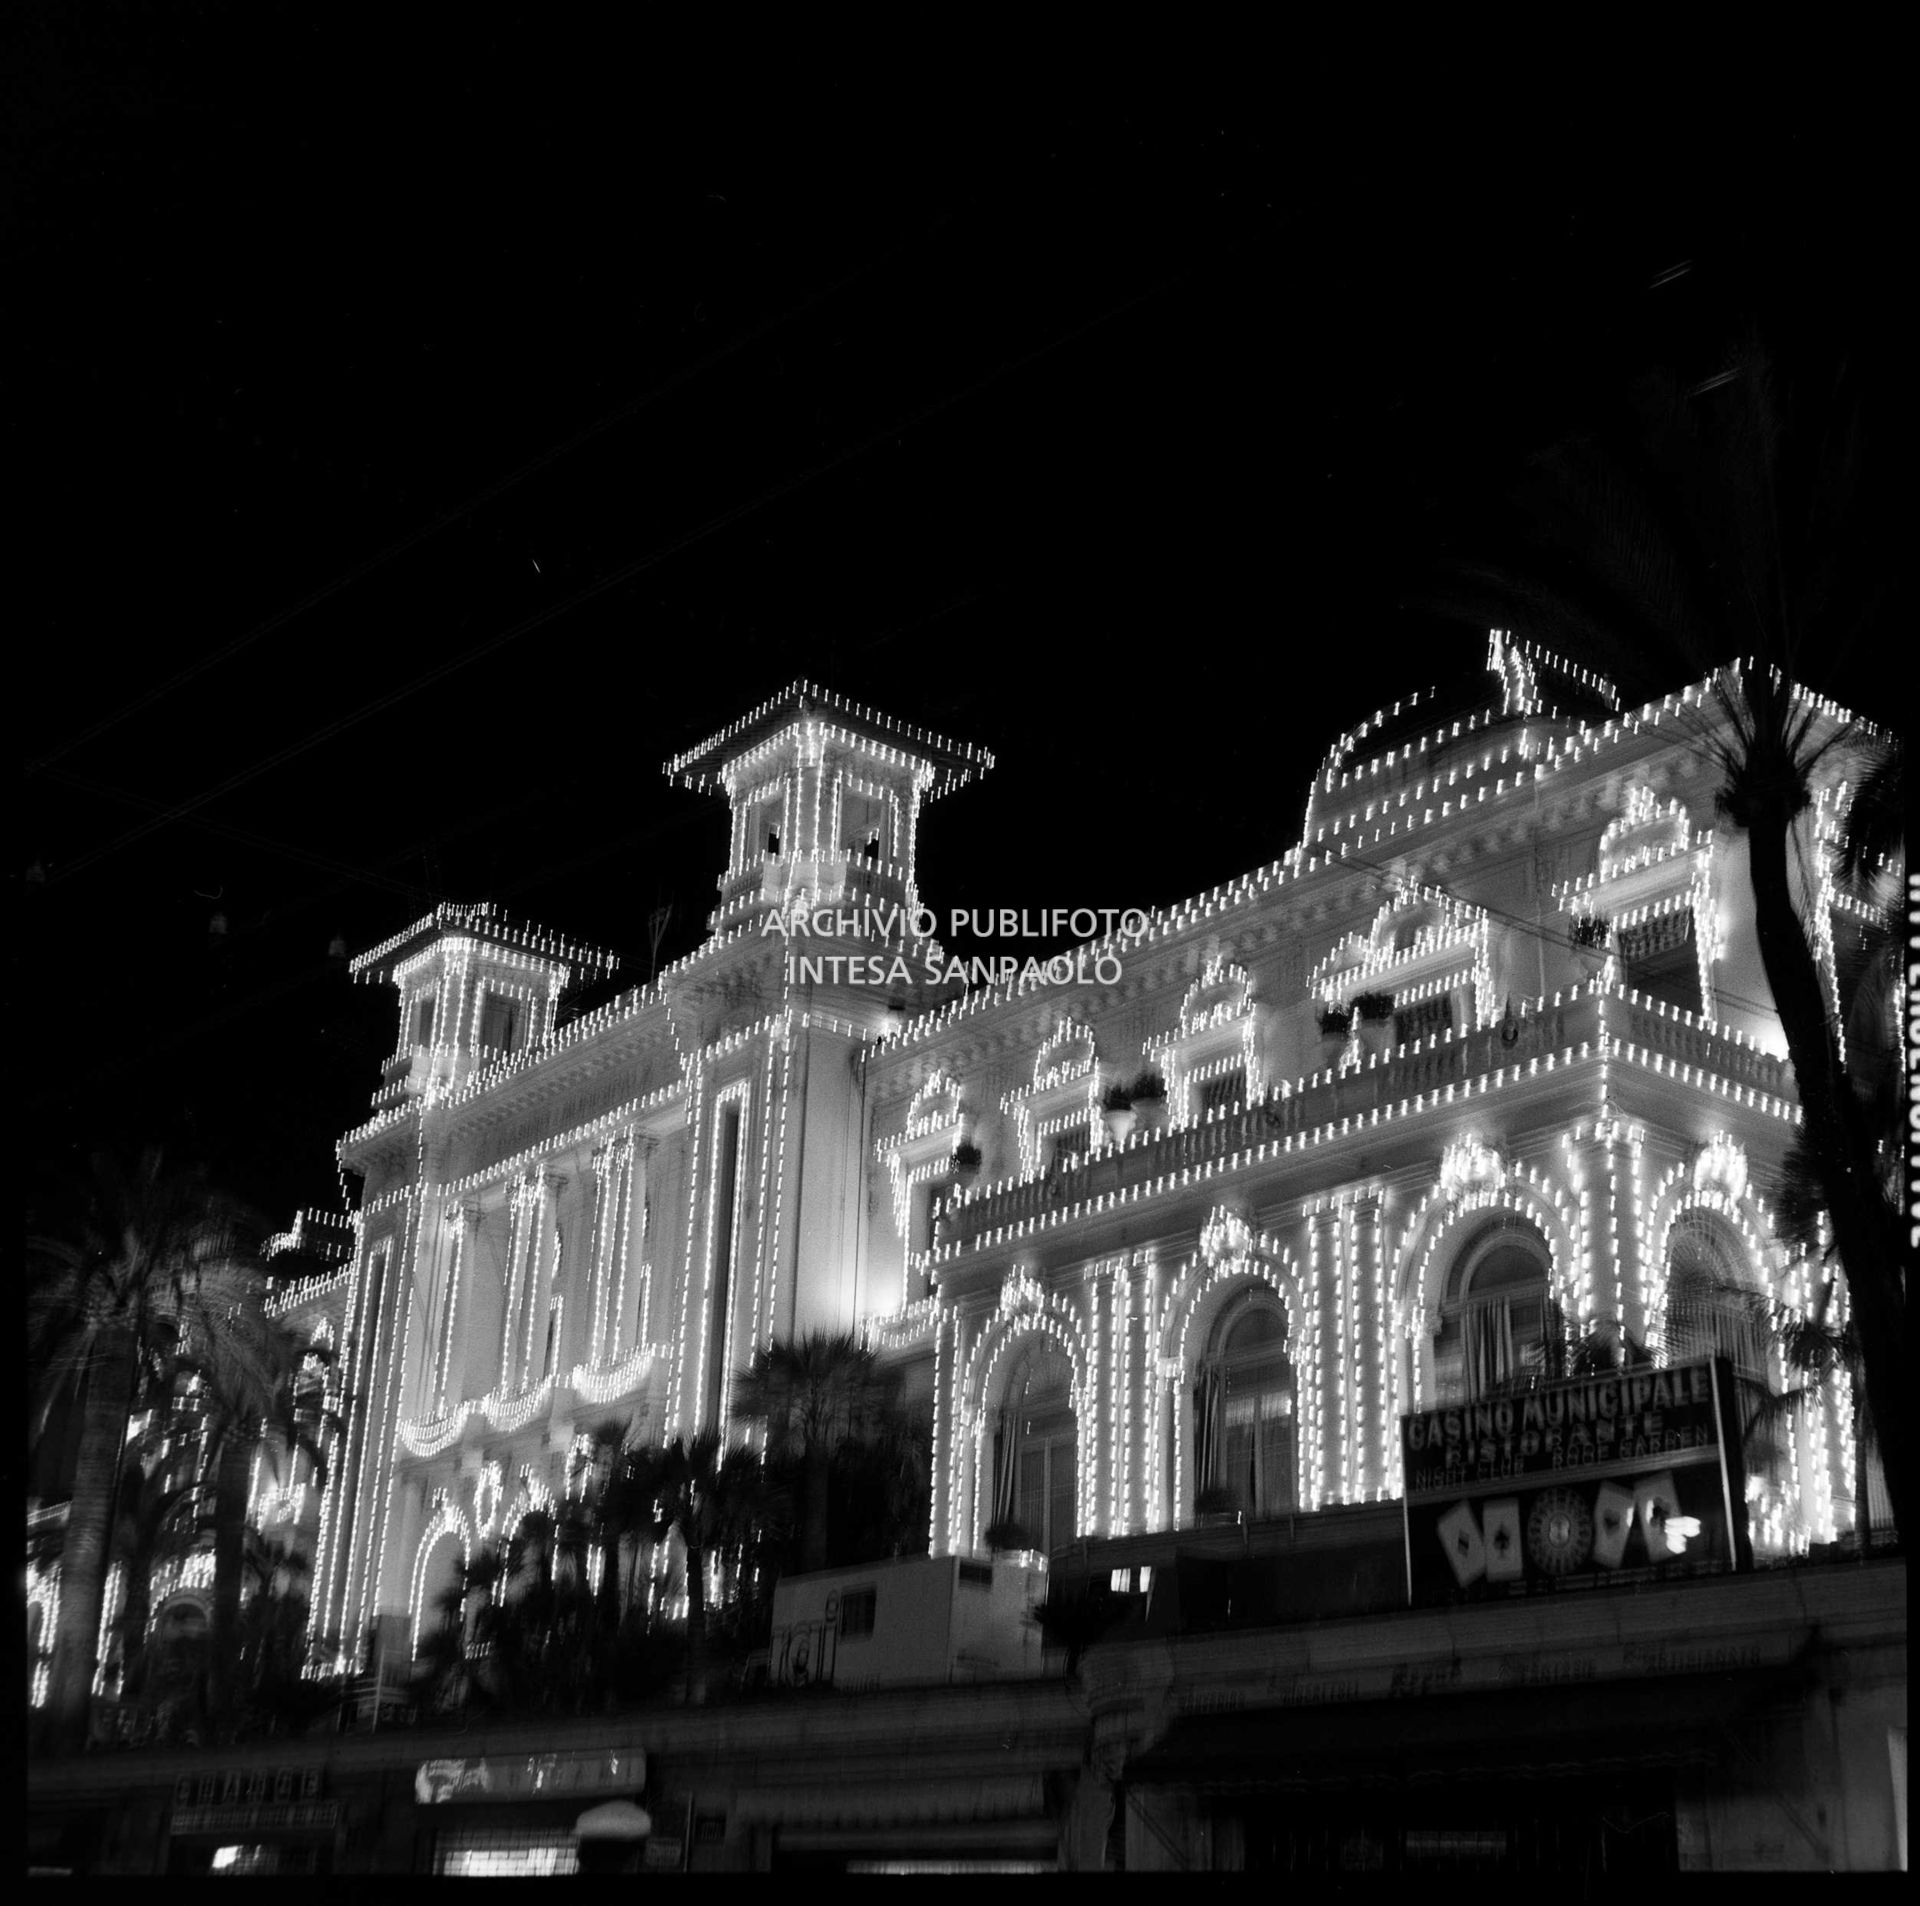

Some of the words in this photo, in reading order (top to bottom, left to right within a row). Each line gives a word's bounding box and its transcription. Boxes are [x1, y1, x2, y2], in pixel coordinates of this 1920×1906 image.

[1408, 1400, 1515, 1452] CASINO
[1522, 1367, 1710, 1433] MUNICIPALE
[1444, 1409, 1665, 1468] RISTORANTE
[1415, 1464, 1467, 1492] NIGHT
[1477, 1453, 1525, 1480] CLUB
[1618, 1422, 1709, 1460] GARDEN
